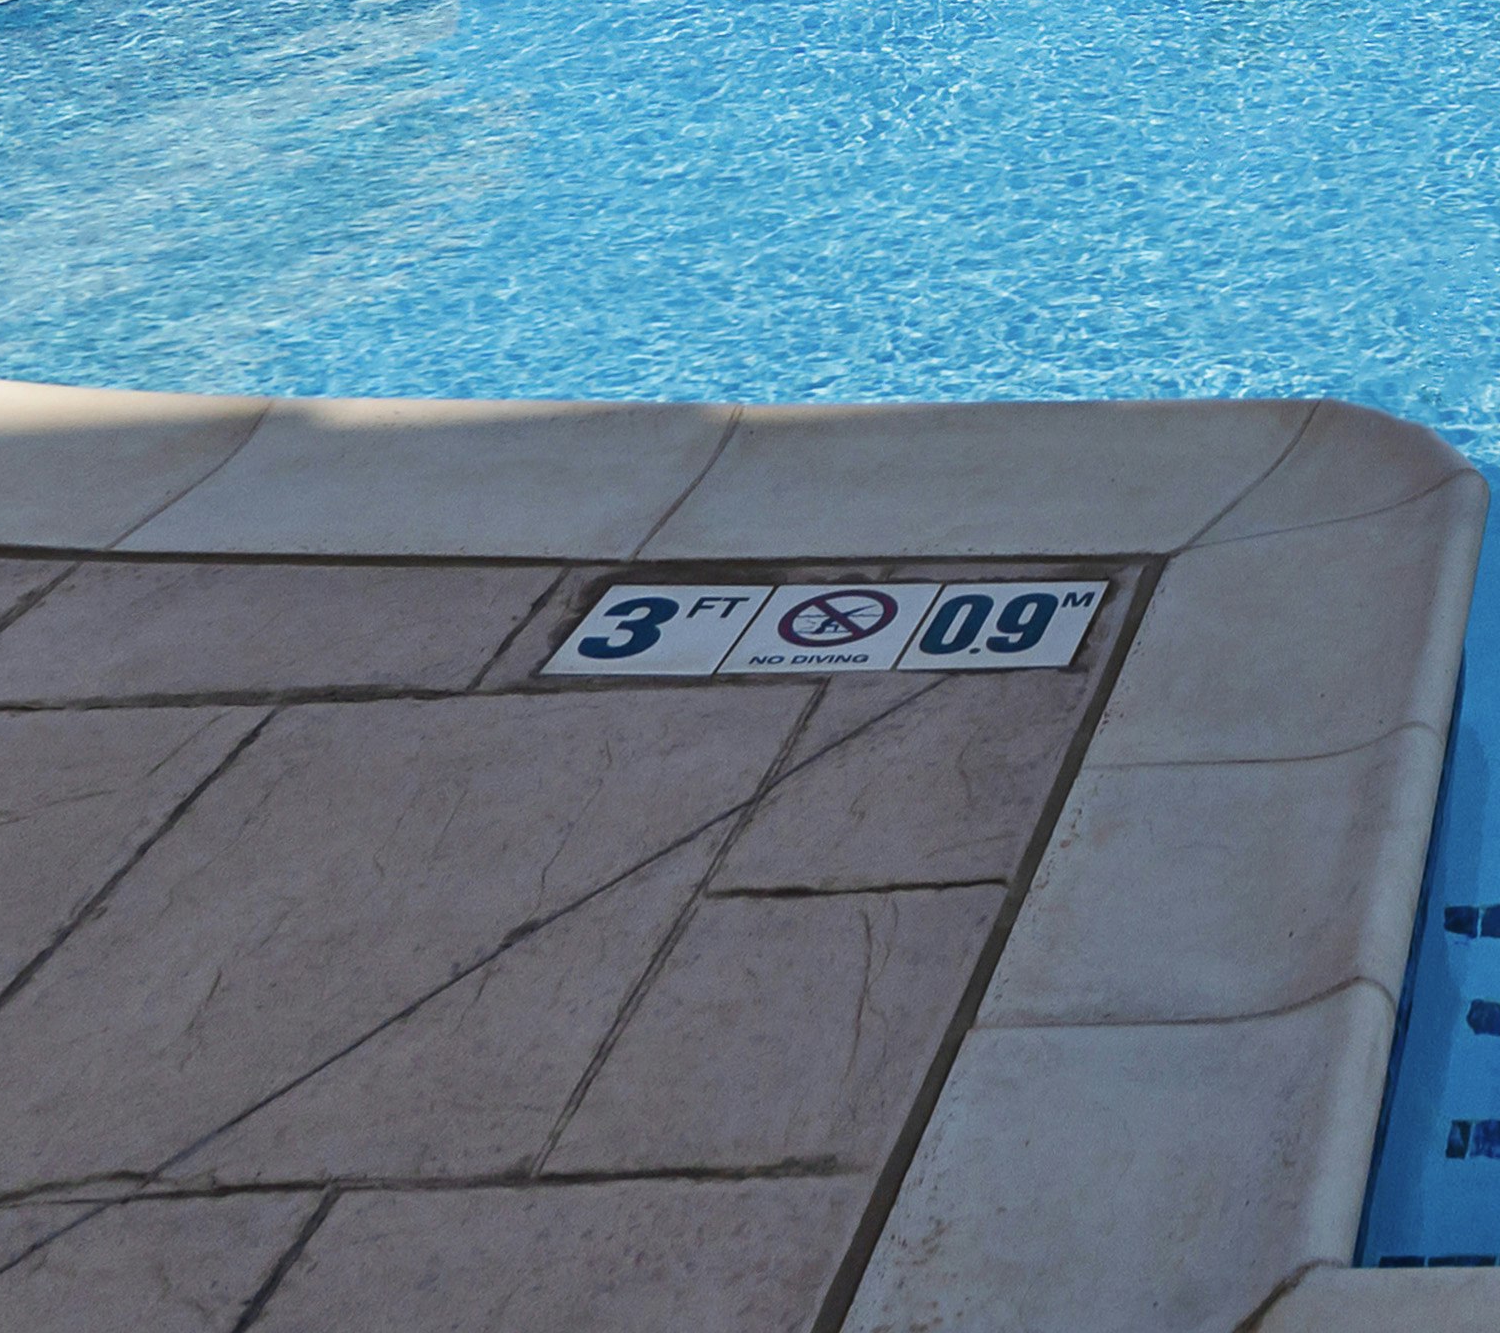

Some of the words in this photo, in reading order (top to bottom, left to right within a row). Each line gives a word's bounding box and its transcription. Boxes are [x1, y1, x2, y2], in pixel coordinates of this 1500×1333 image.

[577, 597, 680, 660] 3
[685, 596, 750, 619] FT
[918, 593, 1060, 655] 0.9
[1061, 591, 1096, 608] M
[749, 655, 785, 665] NO
[791, 654, 870, 665] DIVING
